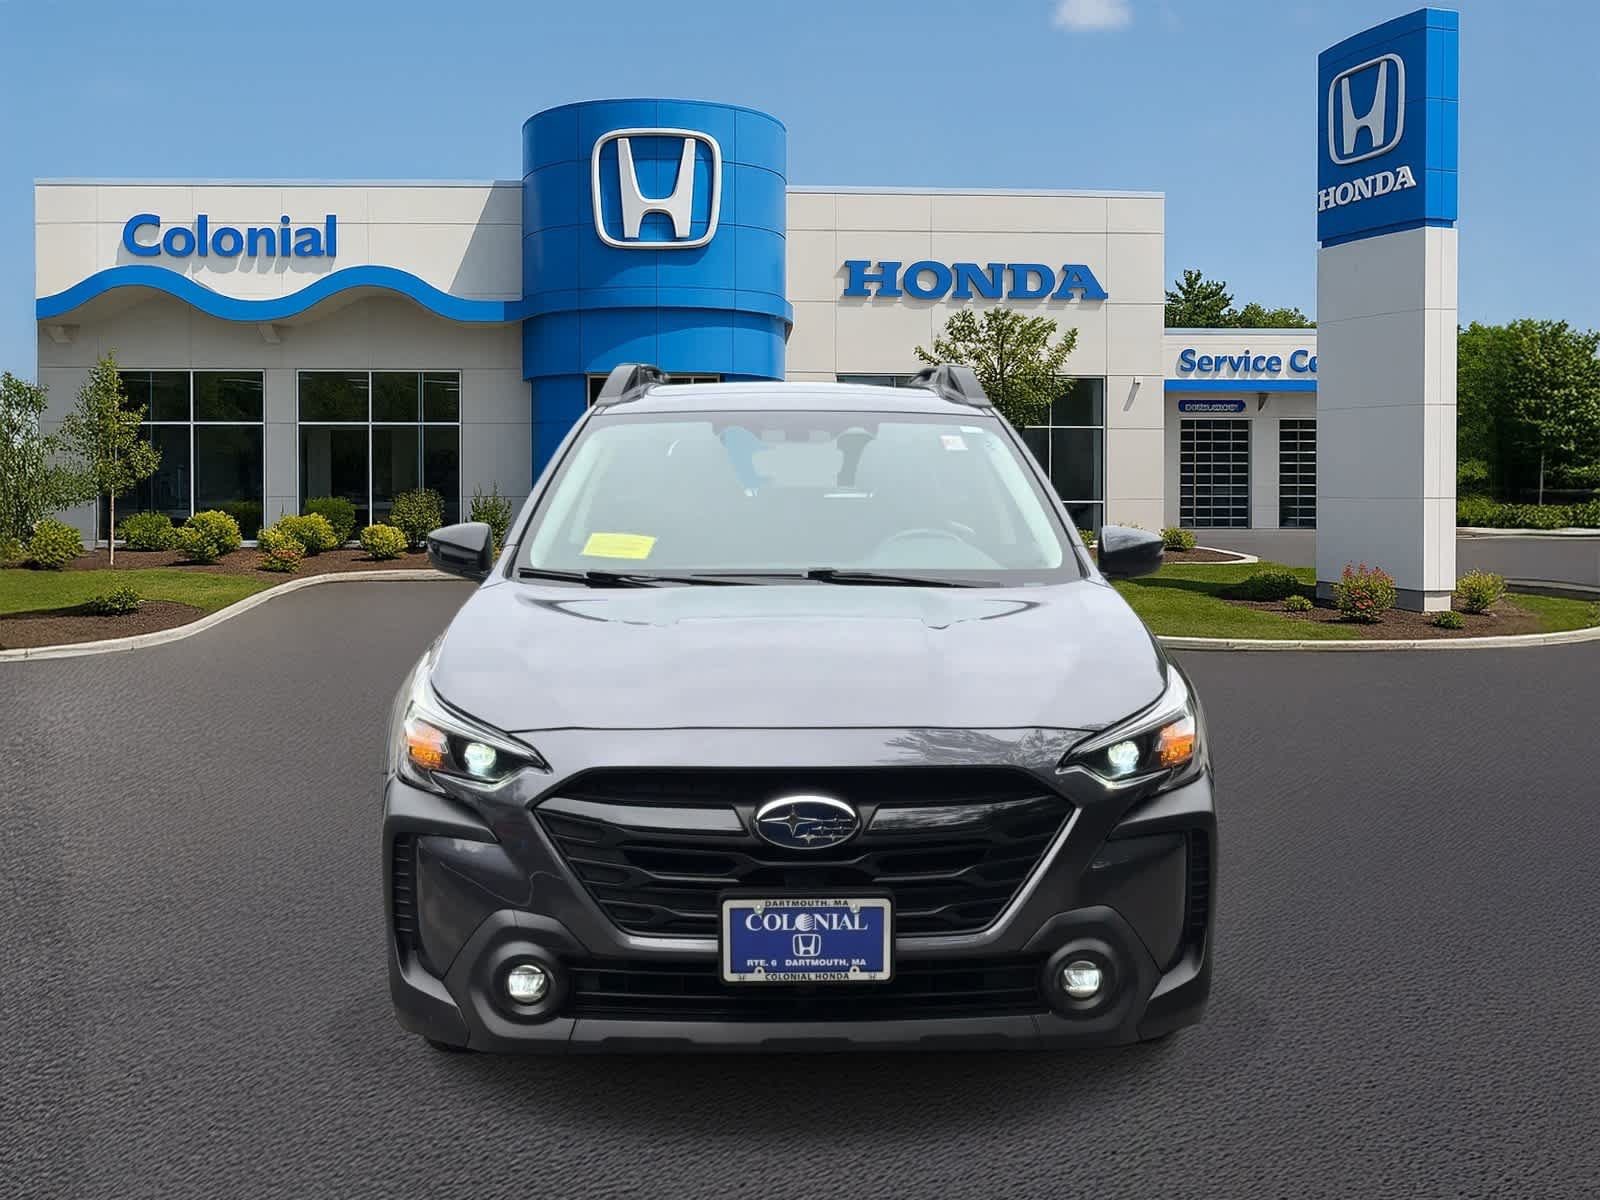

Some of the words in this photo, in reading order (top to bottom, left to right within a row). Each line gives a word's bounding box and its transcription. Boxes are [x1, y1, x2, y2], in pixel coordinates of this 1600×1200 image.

[1318, 166, 1416, 212] HONDA
[122, 213, 337, 257] Colonial
[843, 260, 1108, 300] HONDA
[1180, 349, 1281, 373] Service
[745, 913, 868, 931] COLONIAL
[765, 973, 812, 981] COLONIAL
